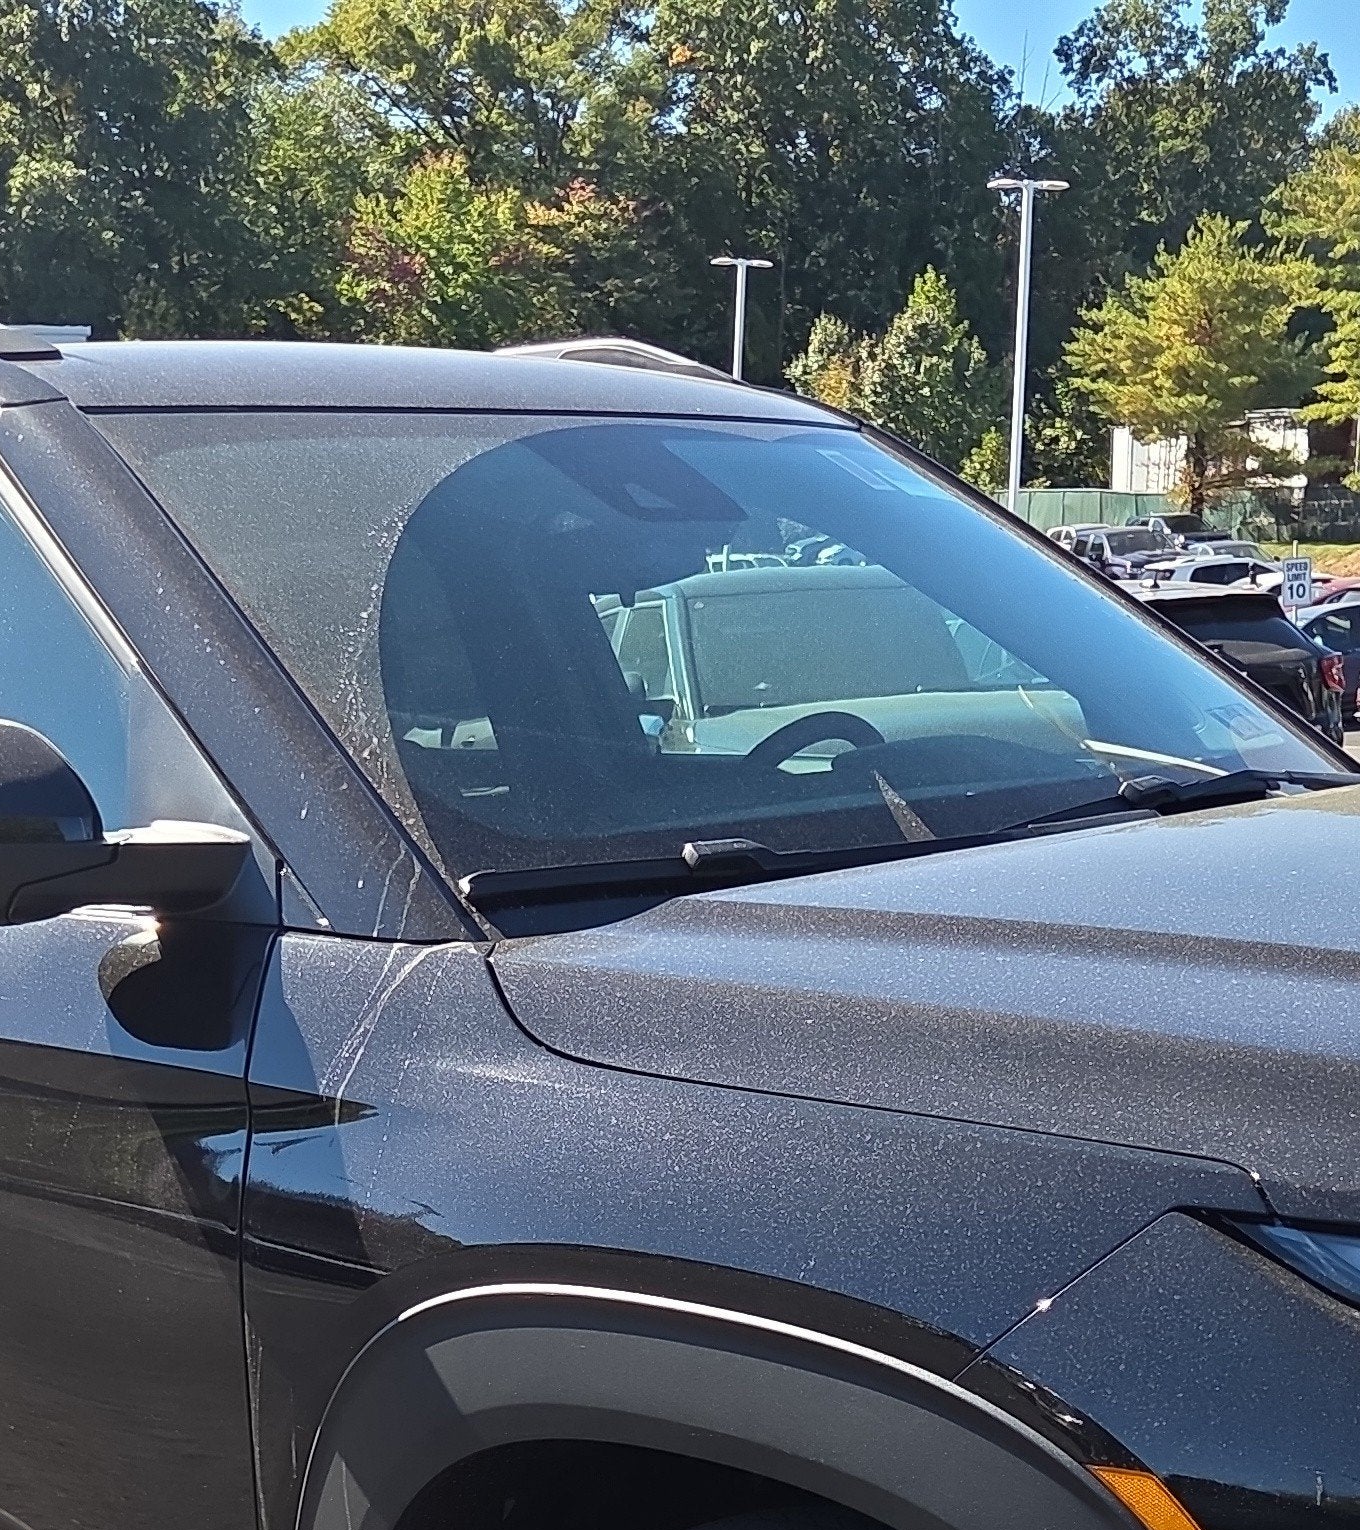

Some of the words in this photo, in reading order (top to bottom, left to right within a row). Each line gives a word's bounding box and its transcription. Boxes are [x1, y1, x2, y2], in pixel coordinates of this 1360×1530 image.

[1285, 561, 1308, 572] SPEED
[1287, 572, 1307, 582] LIMIT
[1287, 583, 1306, 600] 10
